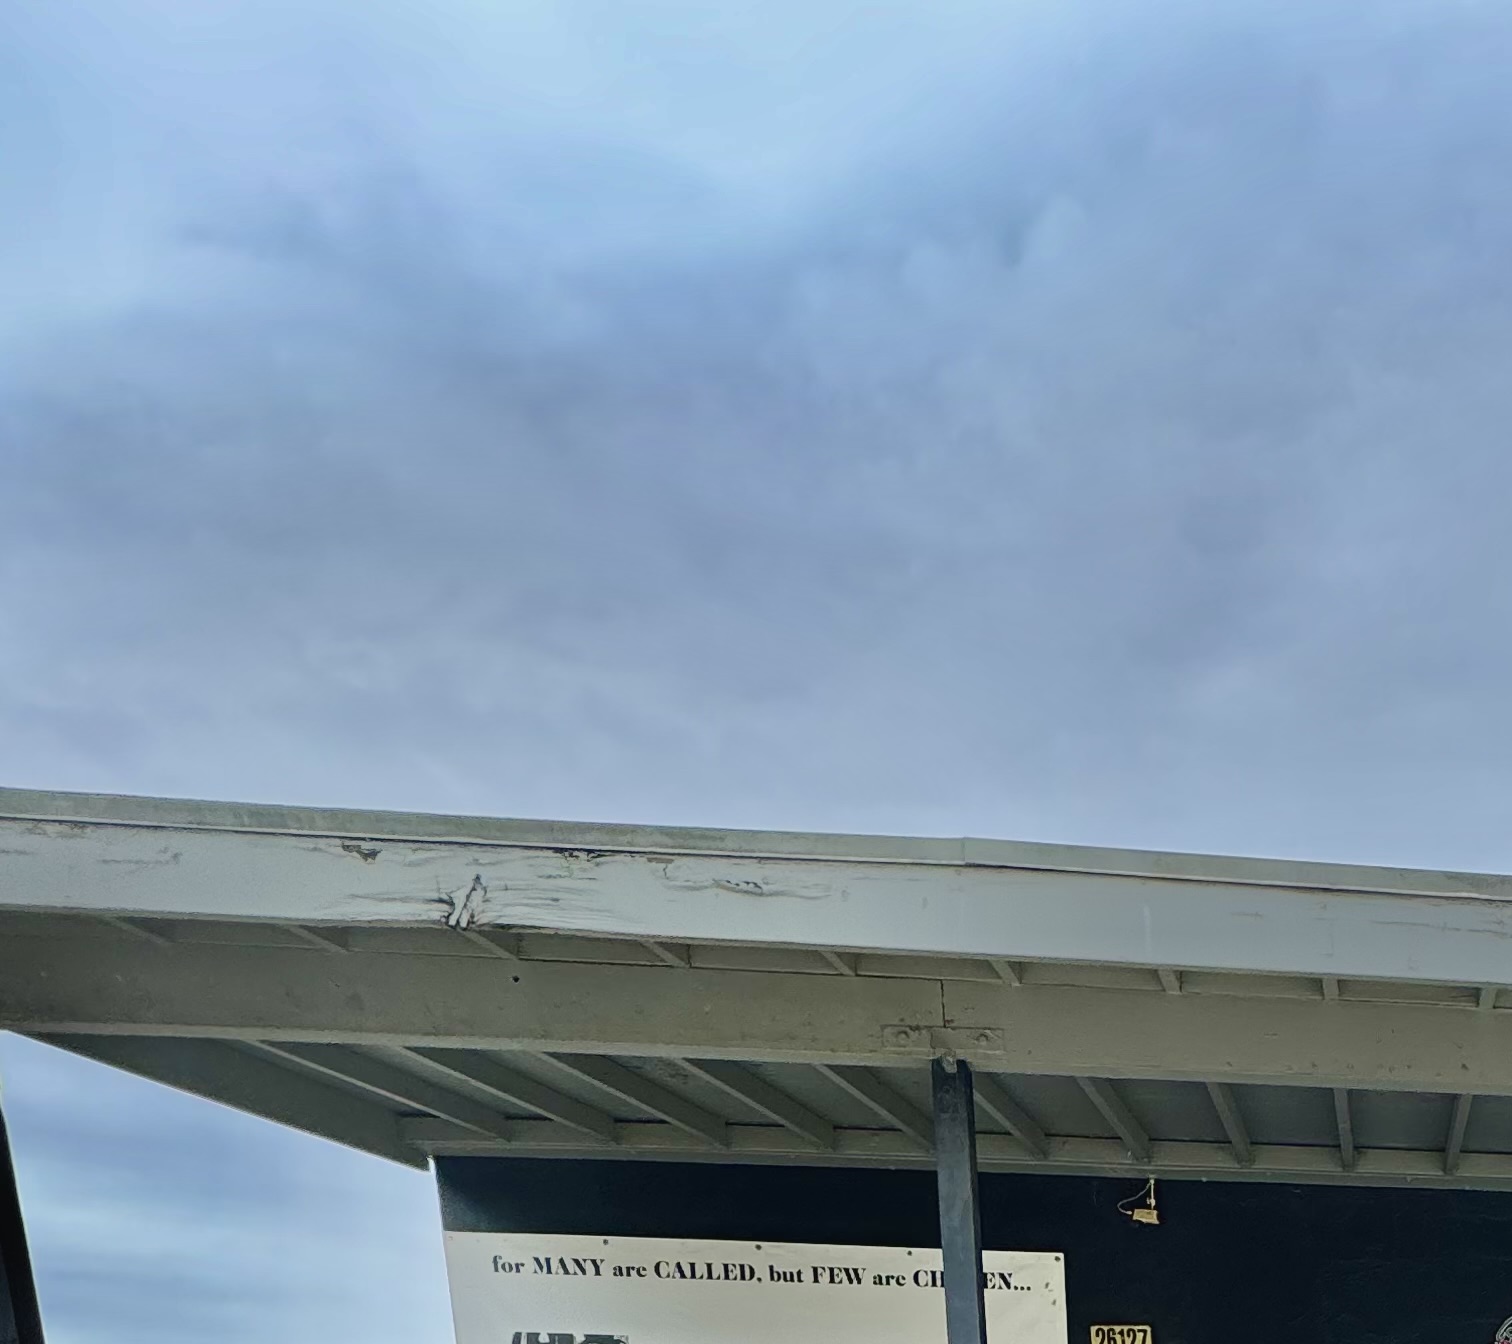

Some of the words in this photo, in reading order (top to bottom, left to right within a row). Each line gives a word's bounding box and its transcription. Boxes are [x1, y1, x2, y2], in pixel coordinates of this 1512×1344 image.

[492, 1255, 525, 1273] for
[532, 1256, 605, 1277] MANY
[612, 1264, 648, 1278] are
[768, 1265, 804, 1283] but
[811, 1266, 867, 1285] FEW
[872, 1273, 907, 1287] are
[912, 1269, 1032, 1291] CHEN...
